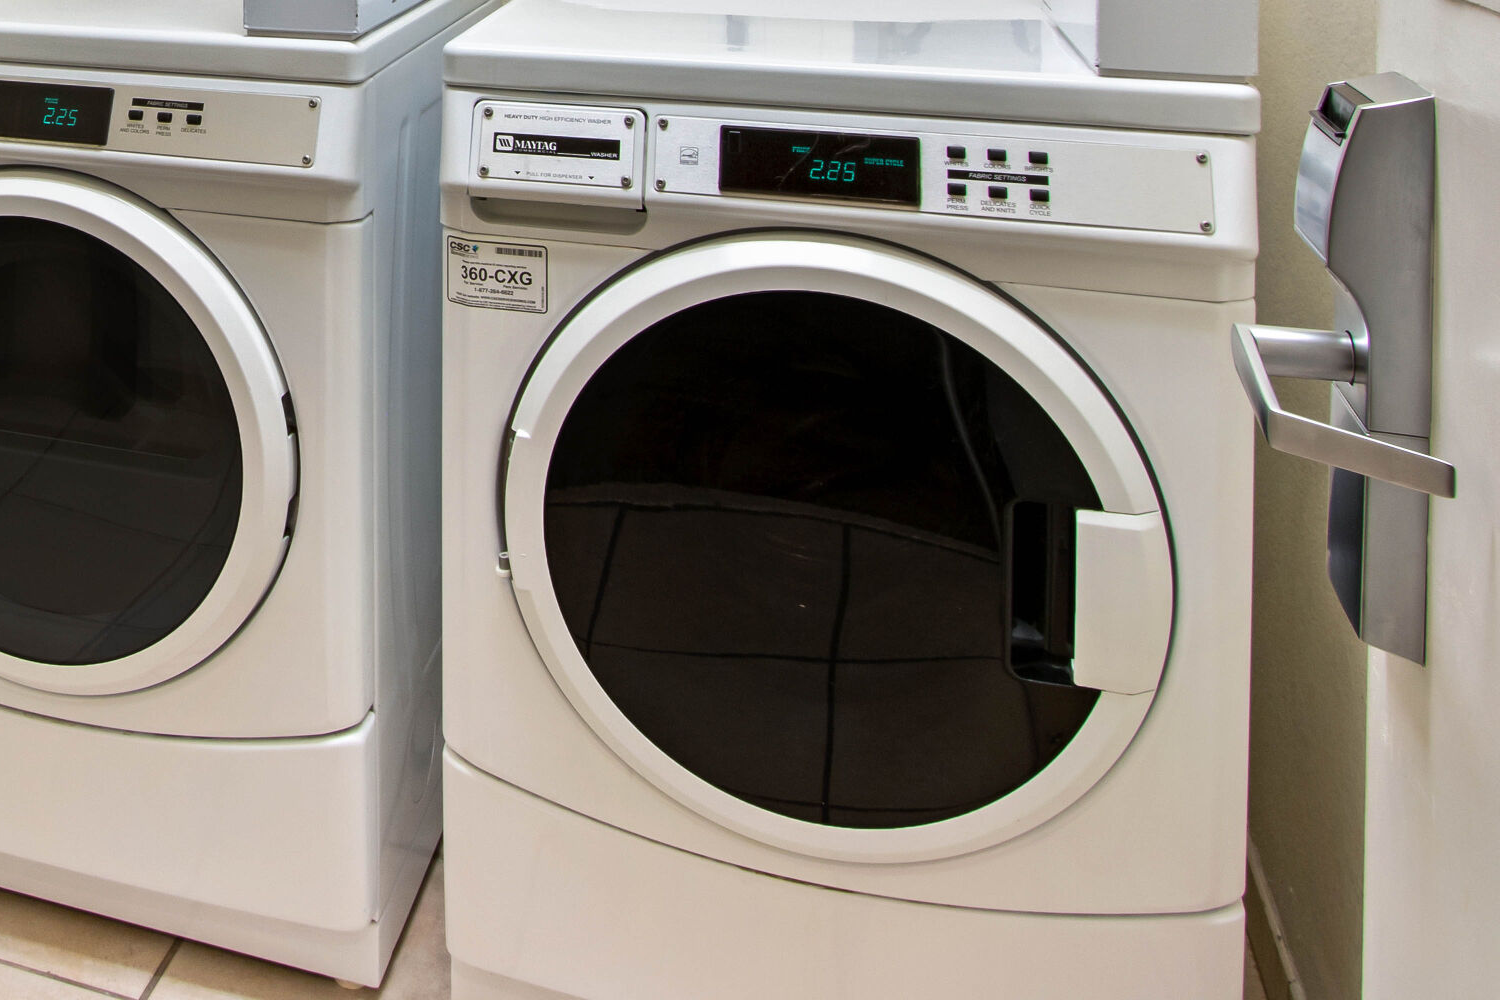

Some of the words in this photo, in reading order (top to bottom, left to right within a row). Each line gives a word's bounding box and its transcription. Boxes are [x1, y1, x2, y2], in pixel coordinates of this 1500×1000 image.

[43, 107, 78, 127] 2.25
[514, 140, 557, 151] MAYTAG
[810, 160, 856, 182] 2.25
[969, 172, 993, 180] FABRIC
[994, 174, 1027, 182] SETTINGS
[981, 200, 1016, 208] DELICATES
[450, 242, 471, 252] CSC
[461, 266, 533, 286] 360-CXG
